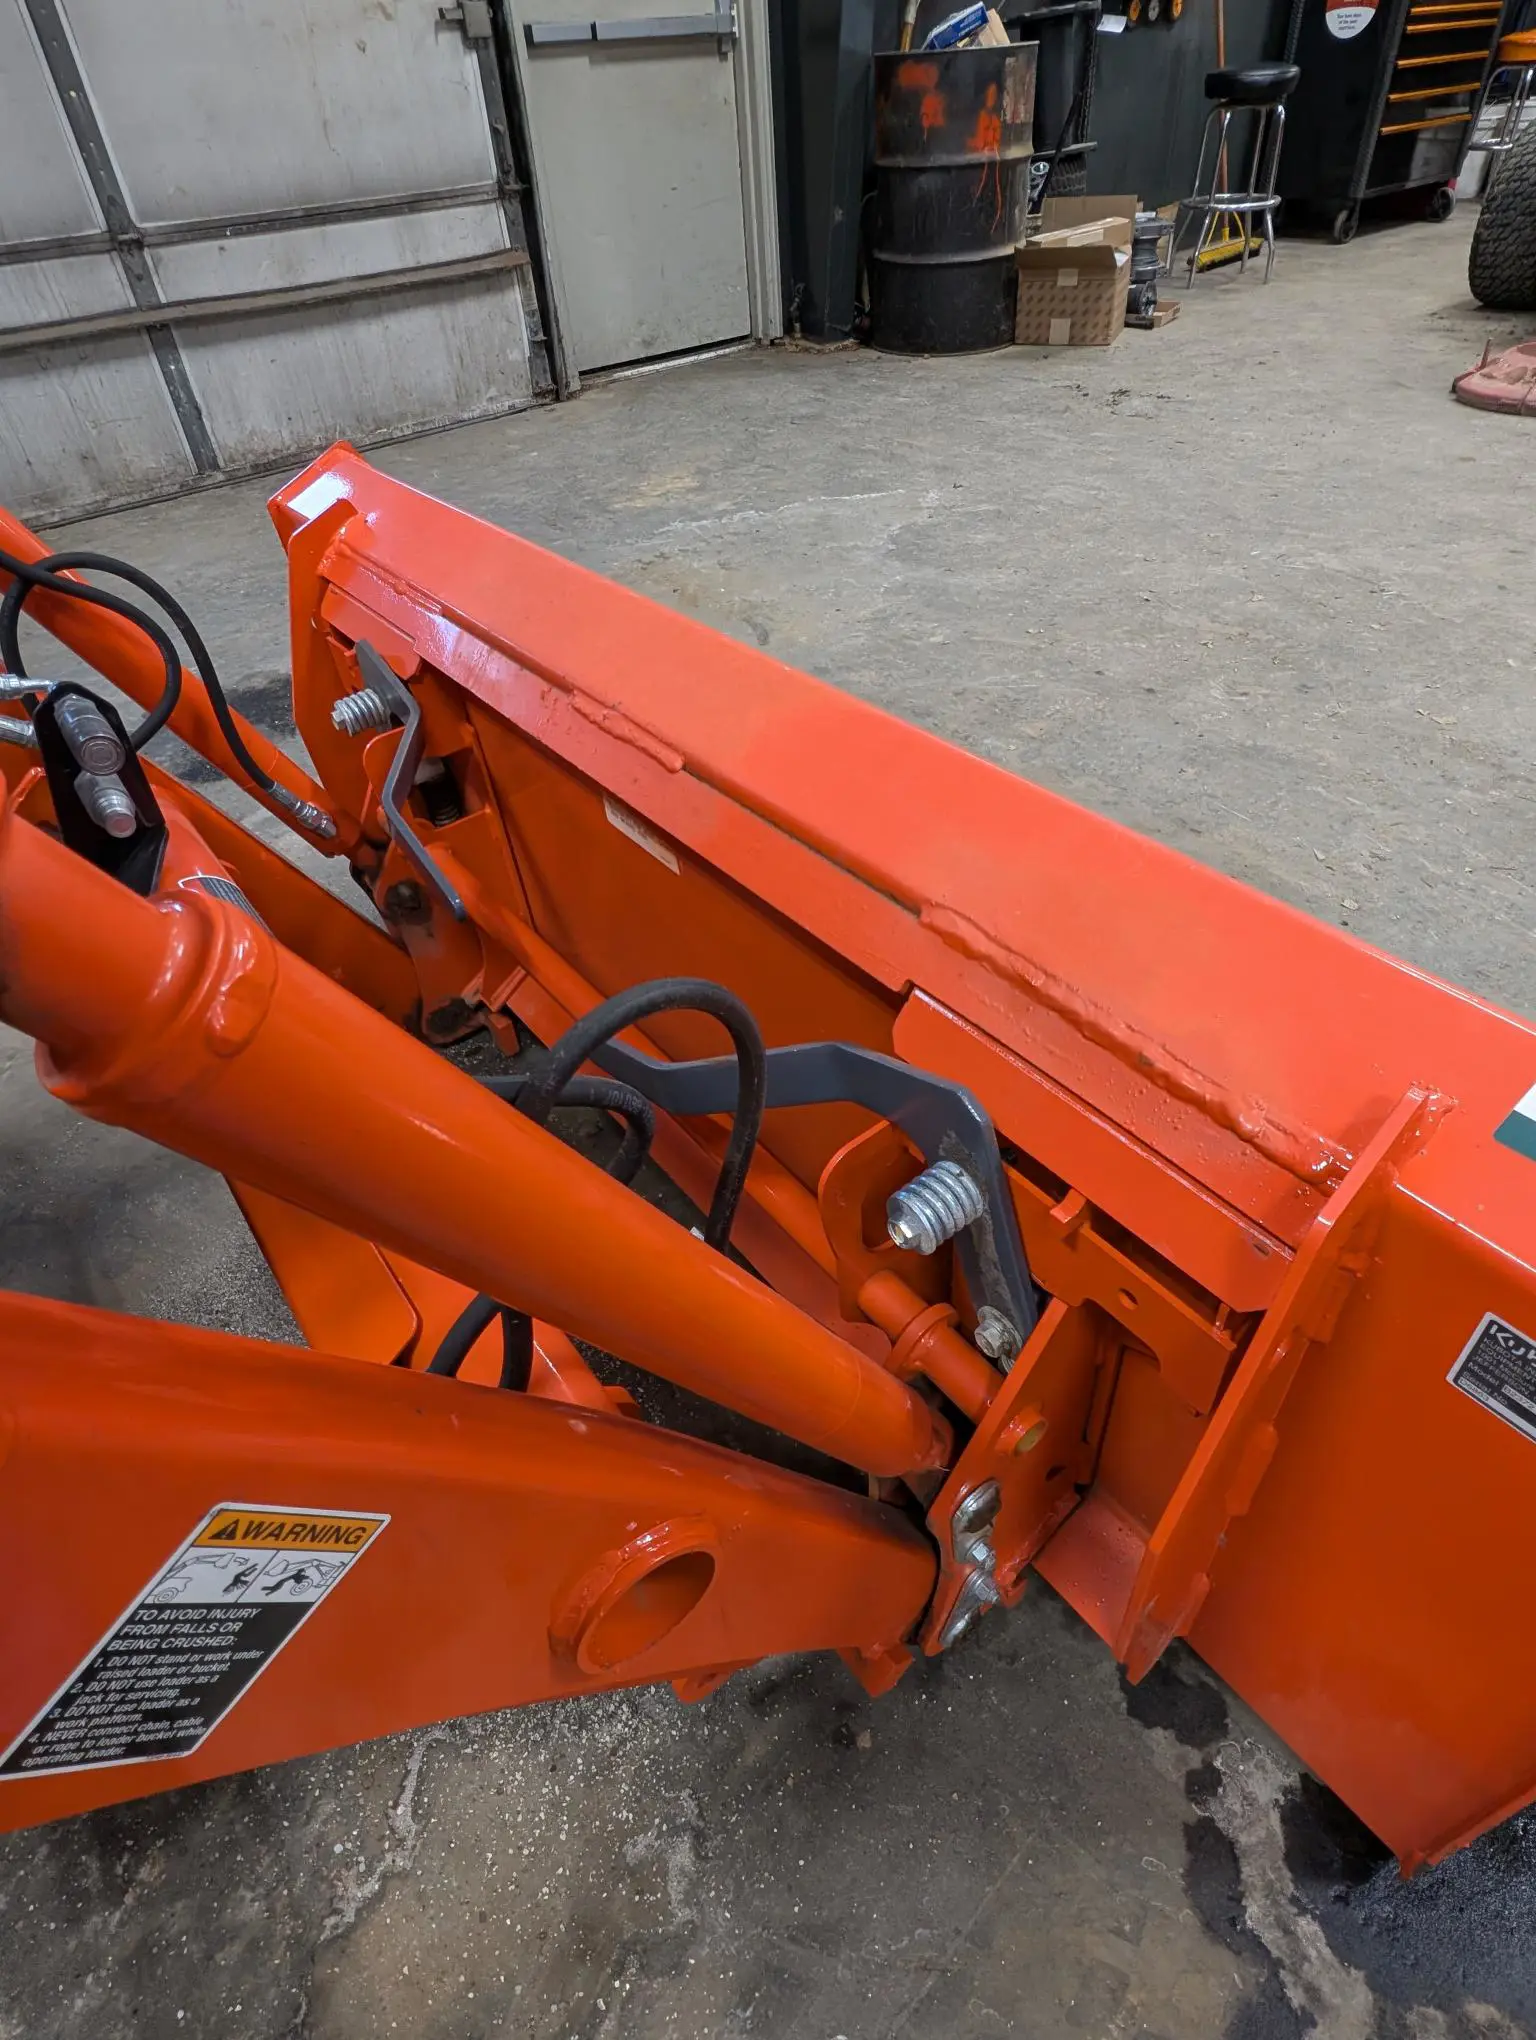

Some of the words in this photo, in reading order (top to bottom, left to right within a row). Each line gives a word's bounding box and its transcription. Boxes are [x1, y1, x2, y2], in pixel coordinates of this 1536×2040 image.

[1477, 1349, 1497, 1365] 1001
[1483, 1337, 1522, 1366] KUBOTA
[1462, 1371, 1491, 1392] Serial
[1468, 1361, 1499, 1385] Model
[241, 1520, 367, 1545] WARNING
[135, 1610, 158, 1621] TO
[157, 1609, 207, 1620] AVOID
[207, 1608, 261, 1619] INJURY
[120, 1624, 171, 1635] FROM
[170, 1623, 219, 1634] FALLS
[220, 1622, 243, 1632] OR
[107, 1639, 160, 1650] BEING
[161, 1636, 237, 1648] CRUSHED:
[93, 1658, 103, 1668] 1.
[107, 1656, 128, 1667] DO
[127, 1655, 155, 1666] NOT
[155, 1653, 191, 1664] stand
[190, 1654, 203, 1662] or
[203, 1651, 231, 1662] work
[233, 1650, 264, 1660] under
[97, 1668, 138, 1679] raised
[138, 1666, 176, 1677] loader
[176, 1666, 190, 1674] or
[191, 1662, 230, 1673] bucket.
[70, 1683, 82, 1693] 2.
[86, 1681, 108, 1692] DO
[107, 1679, 136, 1691] NOT
[135, 1679, 158, 1689] use
[158, 1676, 194, 1687] loader
[194, 1676, 209, 1684] as
[210, 1675, 219, 1683] a
[72, 1694, 102, 1706] jack
[107, 1692, 127, 1702] for
[127, 1688, 180, 1700] servicing.
[49, 1708, 62, 1718] 3.
[64, 1706, 87, 1717] DO
[86, 1704, 115, 1715] NOT
[114, 1704, 137, 1713] use
[138, 1700, 175, 1711] loader
[176, 1698, 190, 1707] as
[191, 1697, 200, 1705] a
[54, 1718, 86, 1729] work
[87, 1713, 143, 1728] platform.
[28, 1733, 40, 1743] 4.
[42, 1729, 88, 1742] NEVER
[87, 1724, 138, 1737] connect
[137, 1721, 170, 1732] chain,
[32, 1745, 49, 1754] or
[49, 1742, 81, 1754] rope
[82, 1739, 96, 1748] to
[97, 1735, 136, 1747] loader
[136, 1731, 175, 1742] bucket
[176, 1727, 207, 1736] while
[23, 1751, 86, 1766] operating
[85, 1746, 127, 1759] loader.
